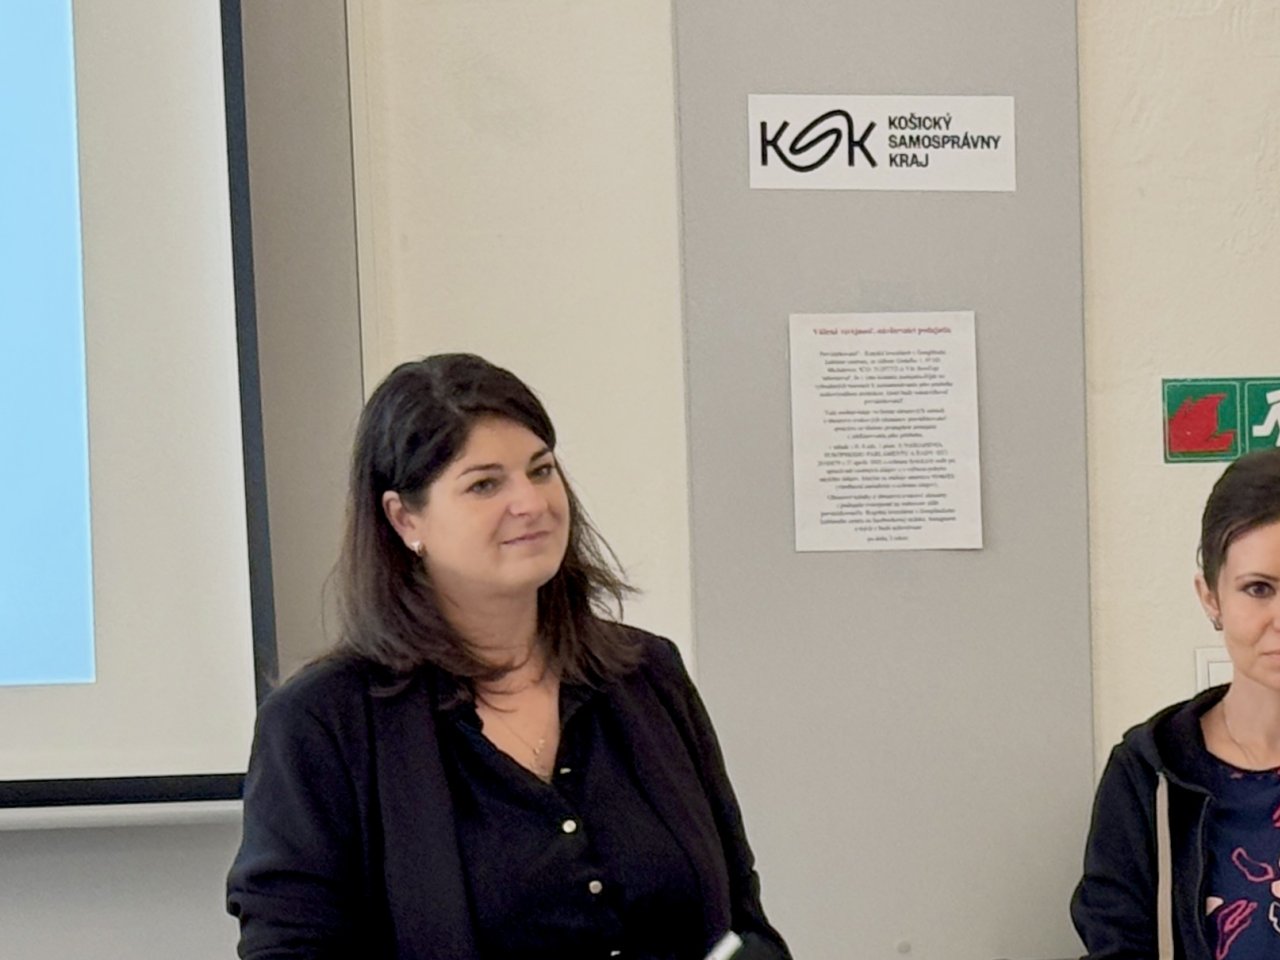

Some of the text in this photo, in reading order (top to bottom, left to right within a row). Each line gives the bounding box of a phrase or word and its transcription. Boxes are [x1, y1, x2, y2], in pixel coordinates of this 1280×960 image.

[888, 113, 952, 131] KOŠICKÝ
[888, 132, 1002, 150] SAMOSPRÁVNY
[889, 153, 930, 168] KRAJ
